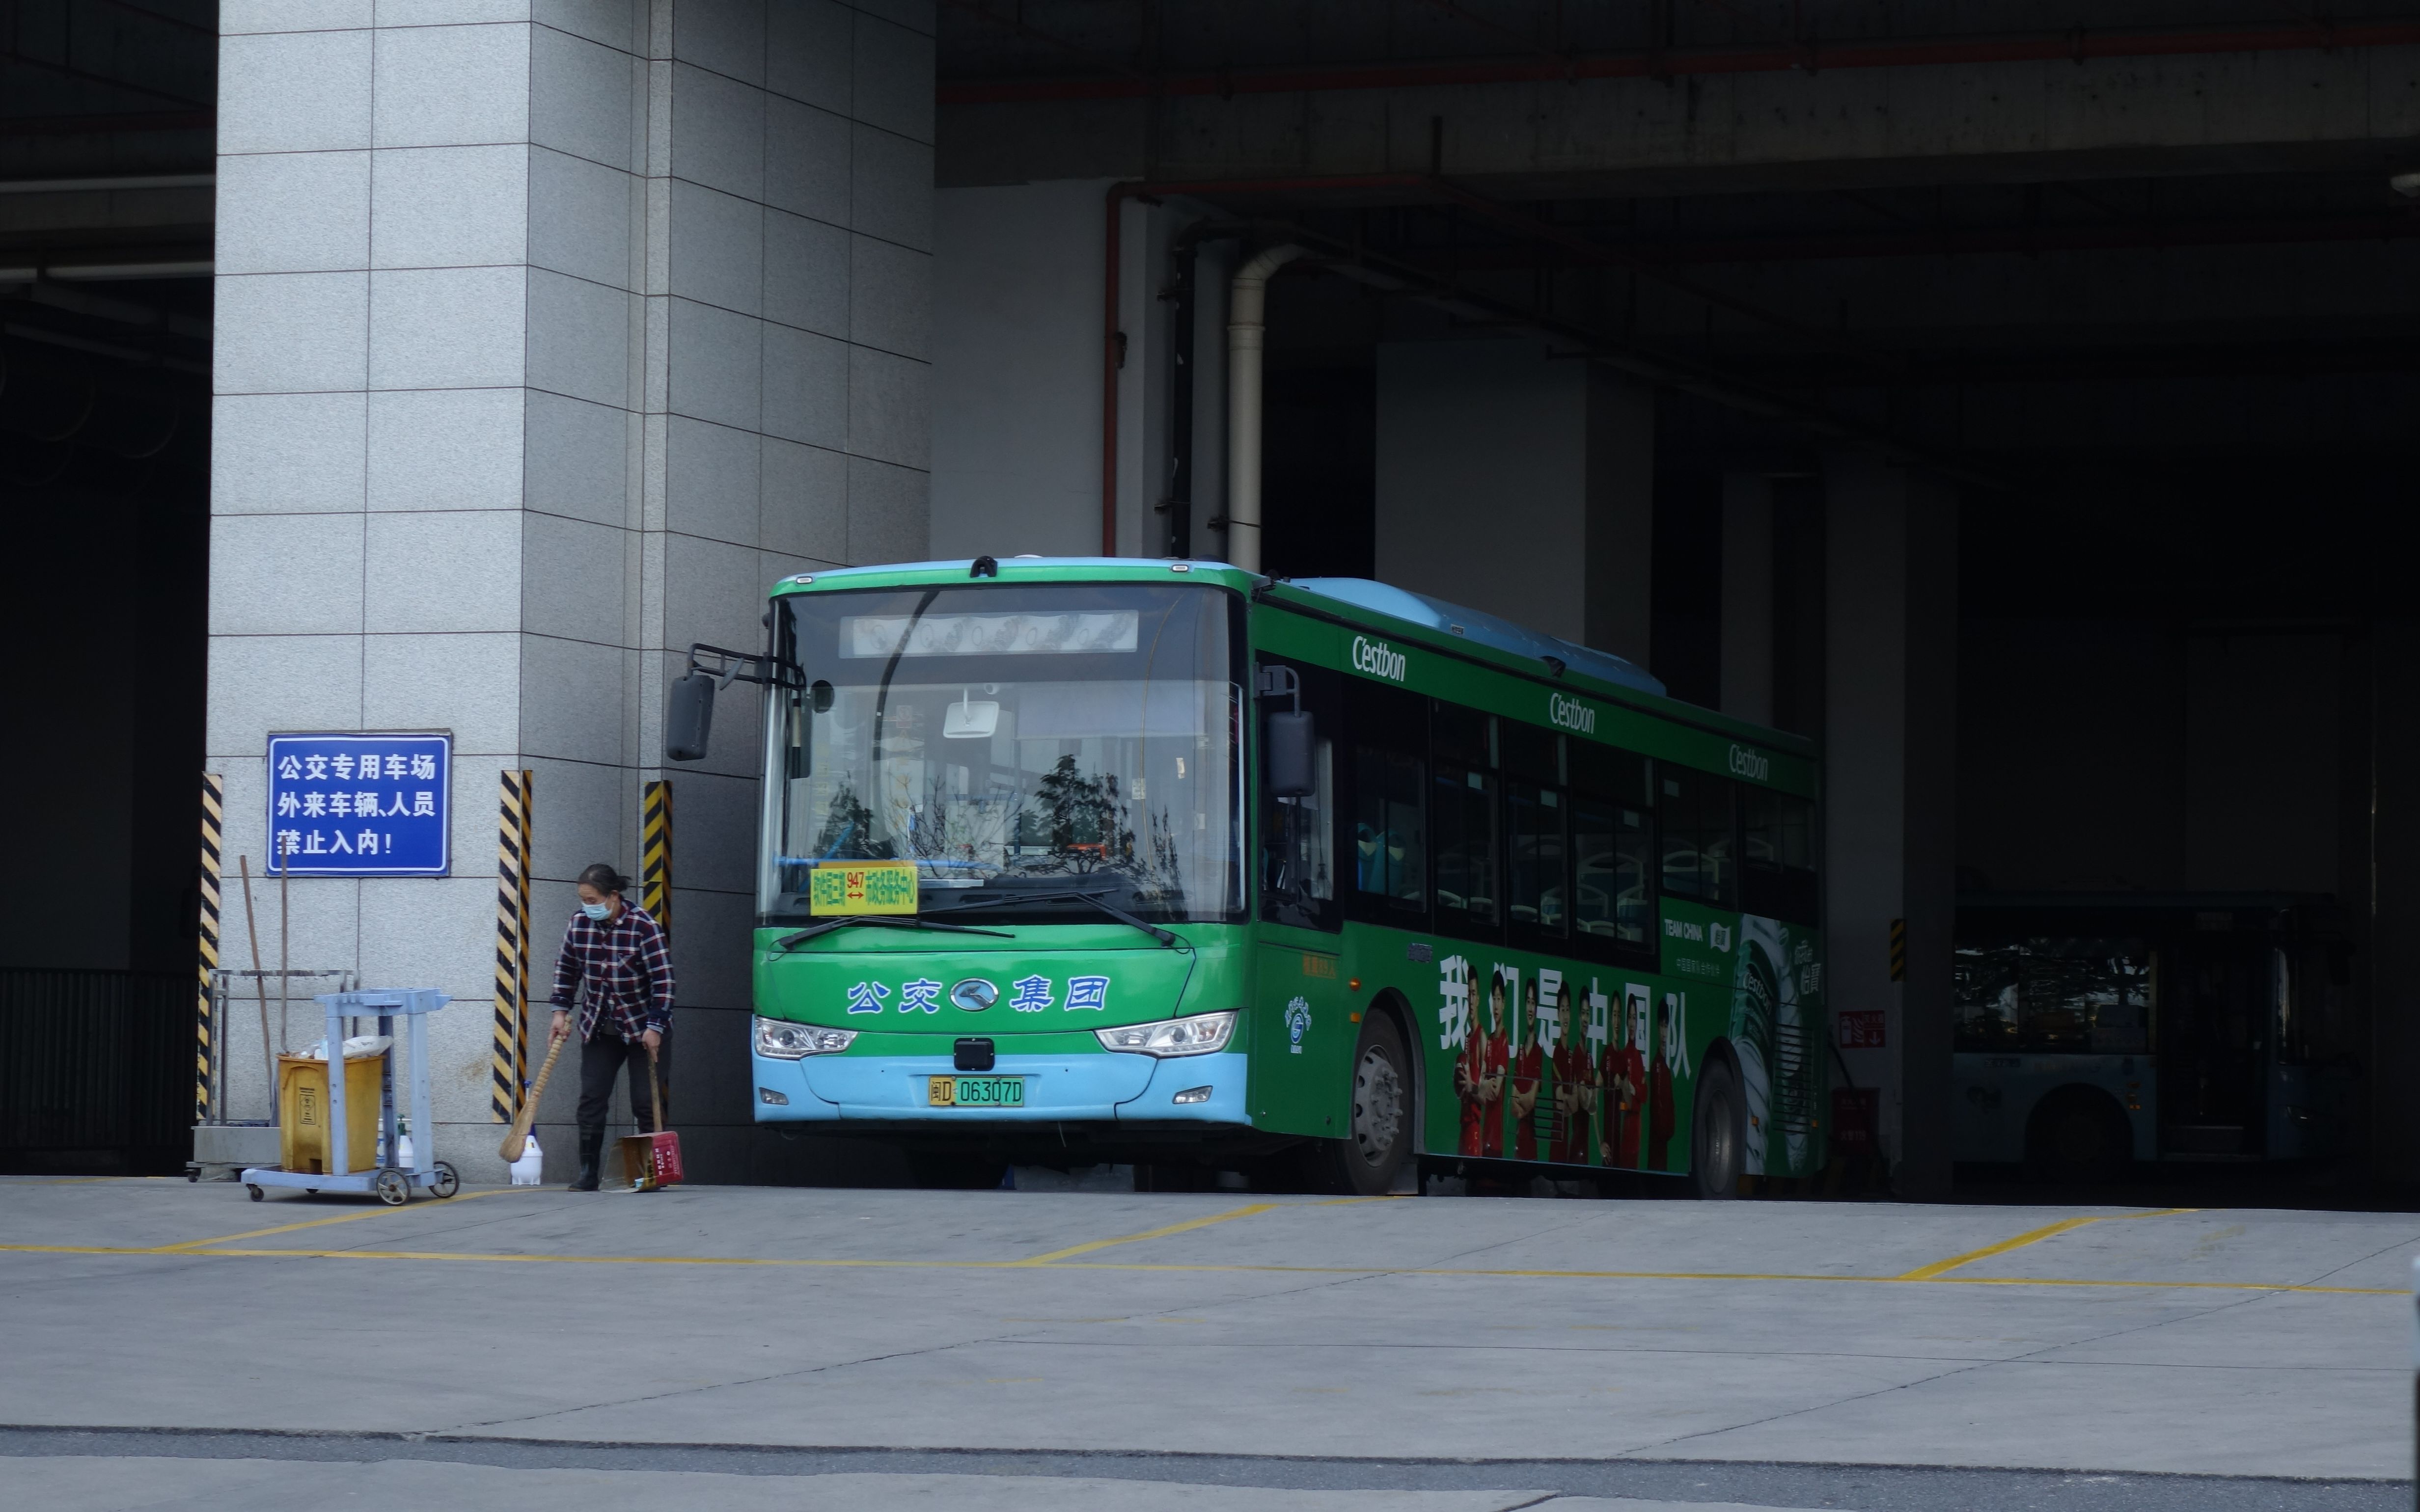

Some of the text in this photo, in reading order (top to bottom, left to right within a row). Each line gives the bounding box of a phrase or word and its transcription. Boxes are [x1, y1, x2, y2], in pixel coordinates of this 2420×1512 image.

[1351, 635, 1406, 683] C'estbon
[1550, 692, 1595, 734] C'estbon
[278, 754, 436, 780] 公交专用车场
[1729, 743, 1768, 782] C'estbon
[277, 791, 436, 818] 外来车辆、人员
[847, 872, 864, 888] 947
[1664, 918, 1682, 938] TEAM
[1683, 922, 1703, 942] CHINA
[848, 974, 1110, 1014] 公交 集团
[1439, 954, 1691, 1080] 我们是中国队
[961, 1081, 1021, 1102] 06307D
